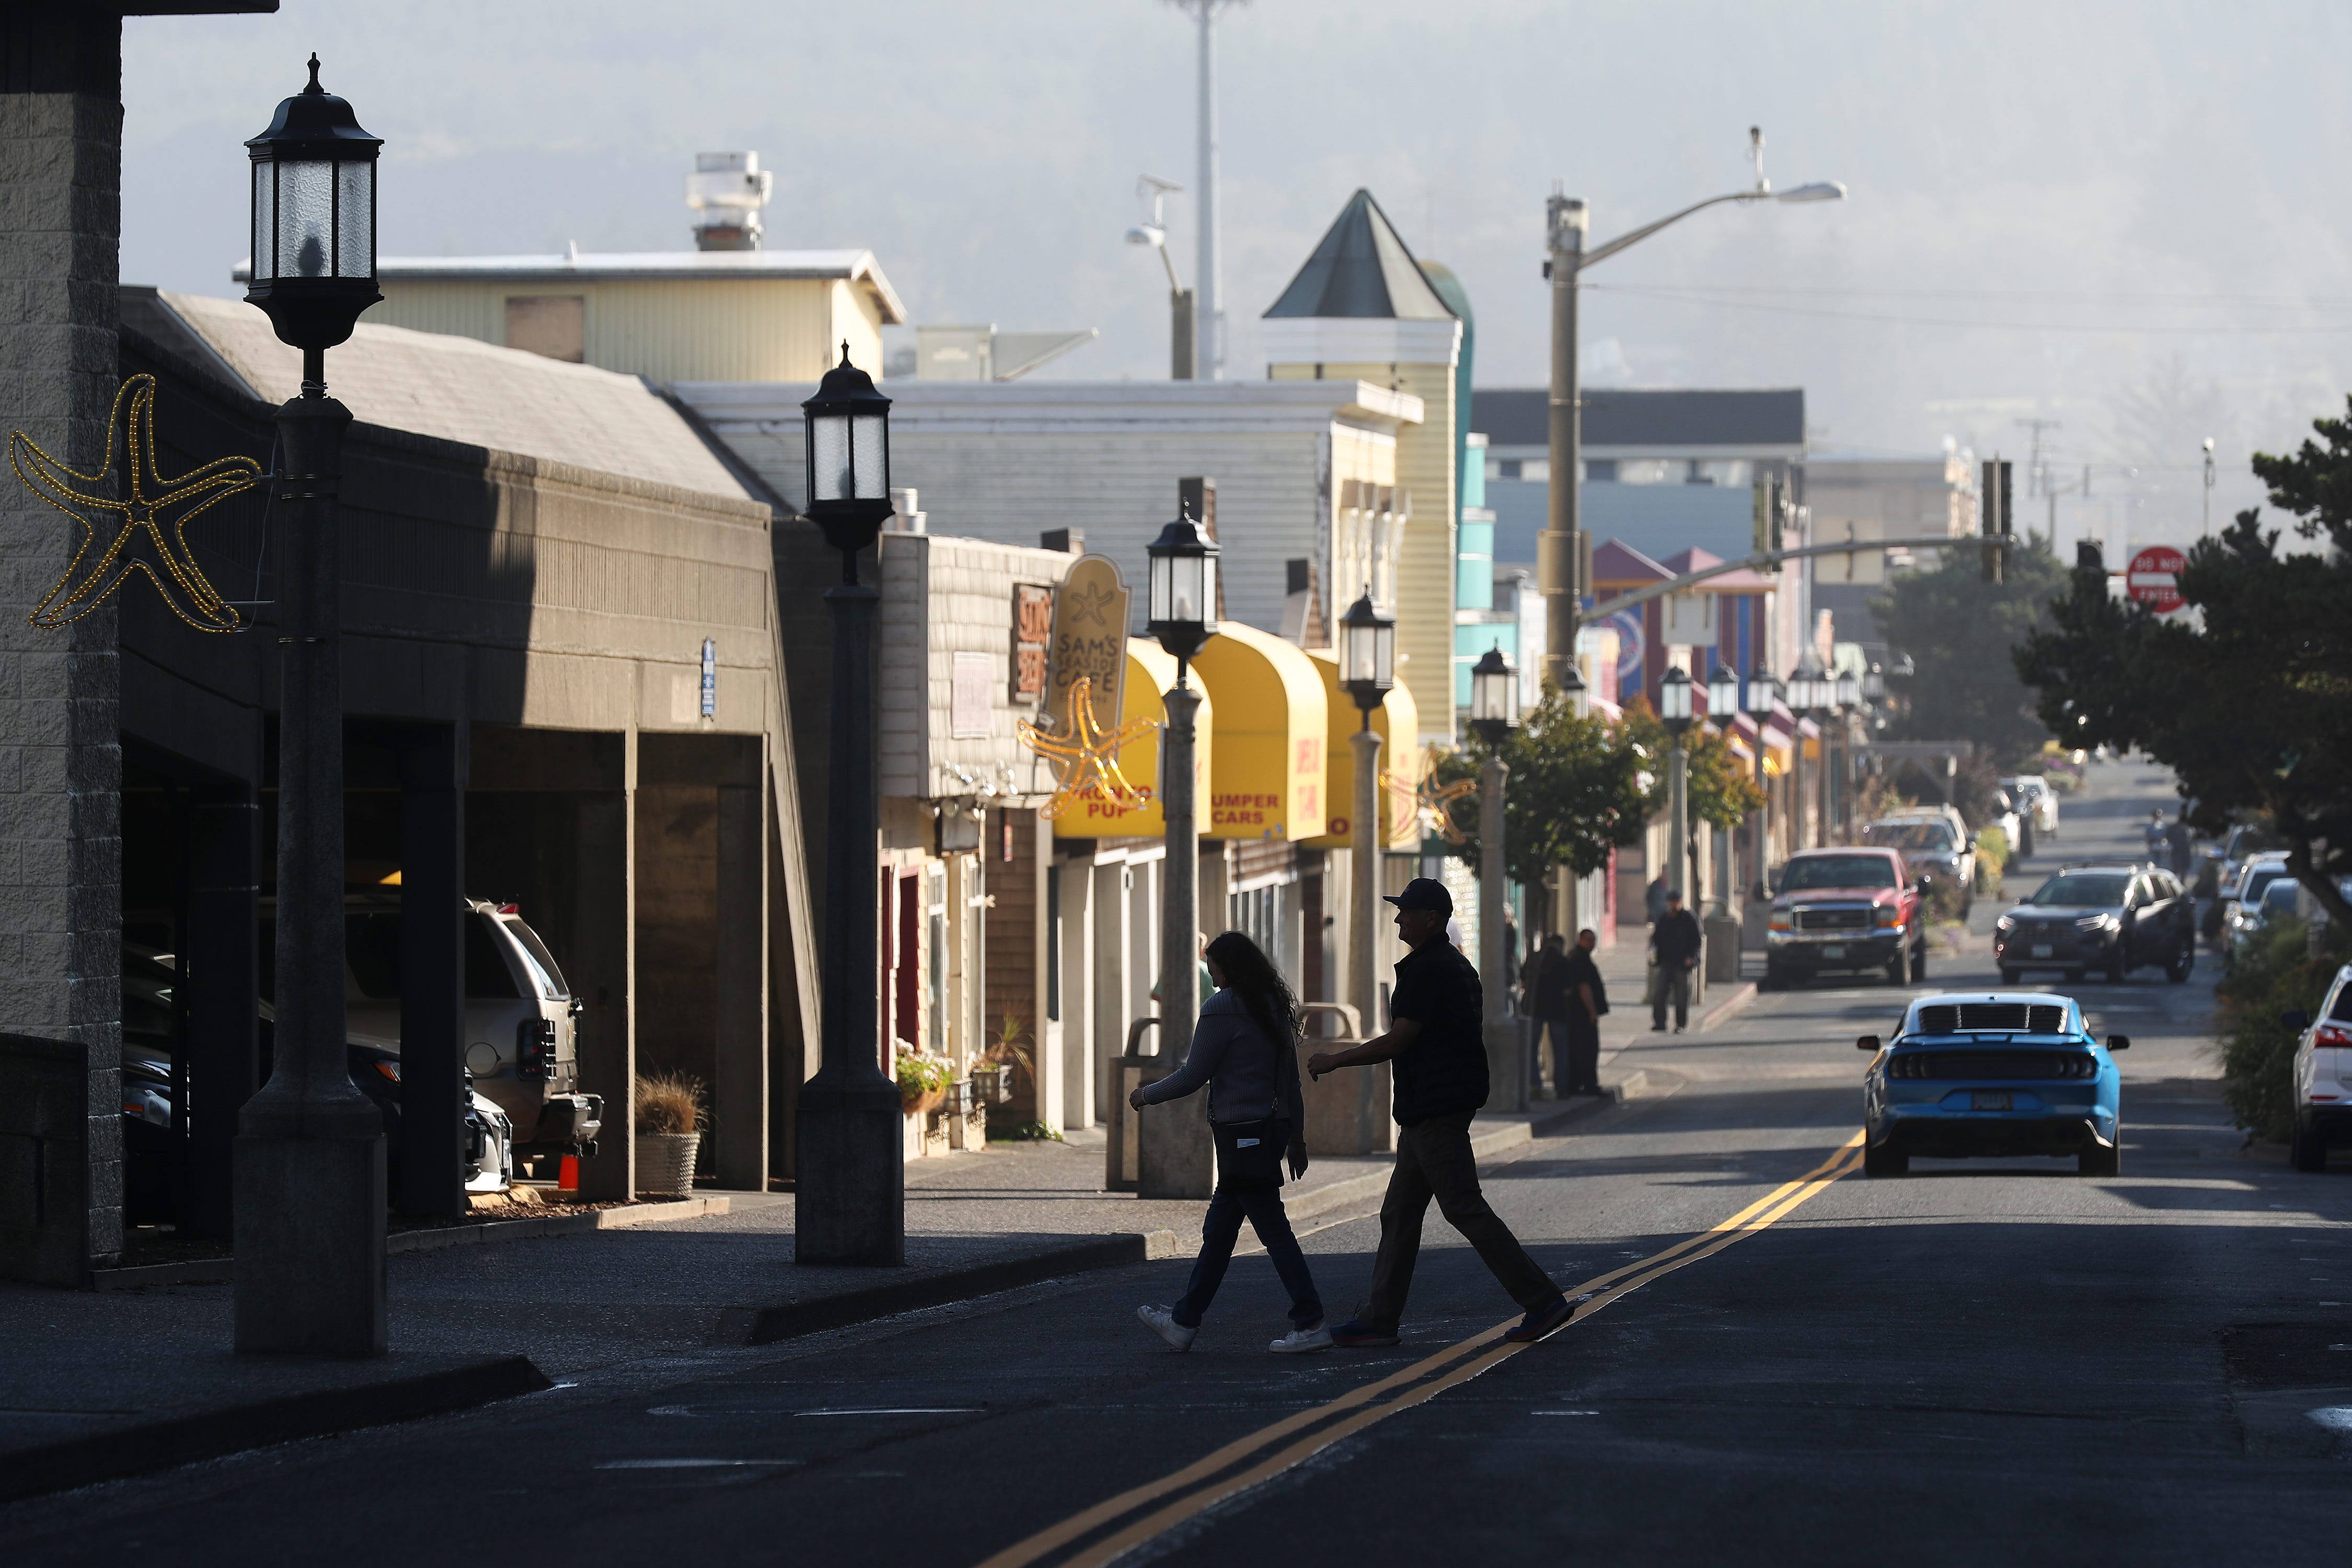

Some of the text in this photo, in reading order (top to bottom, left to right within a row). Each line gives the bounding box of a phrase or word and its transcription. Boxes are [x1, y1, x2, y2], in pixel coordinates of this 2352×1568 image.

[2135, 557, 2185, 572] DO NOT
[2139, 589, 2180, 603] ENTER
[1059, 633, 1117, 657] SAM'S
[1212, 793, 1278, 808] UMPER
[1212, 810, 1264, 824] CARS
